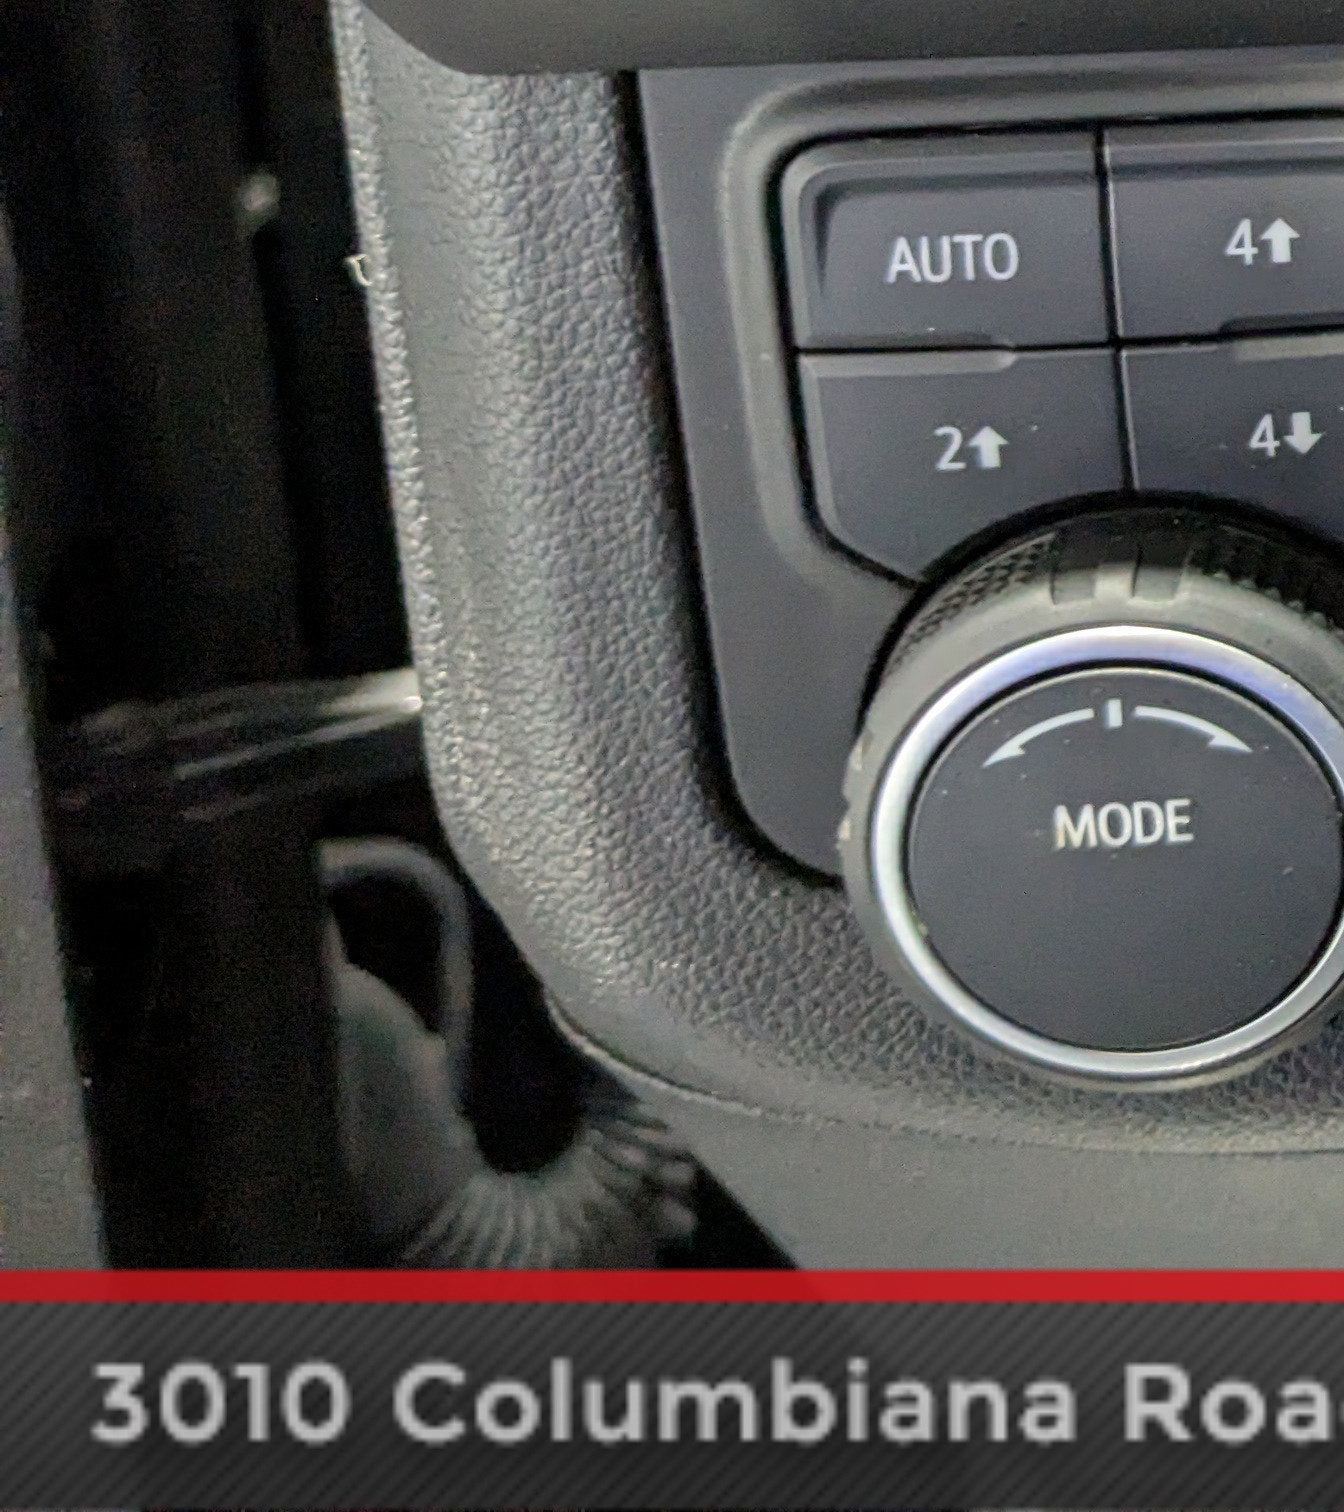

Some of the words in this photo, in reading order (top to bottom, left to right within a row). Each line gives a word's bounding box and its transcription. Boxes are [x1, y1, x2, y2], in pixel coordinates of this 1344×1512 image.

[884, 232, 1020, 284] AUTO
[1224, 218, 1259, 266] 4
[933, 425, 966, 471] 2
[1248, 414, 1281, 458] 4
[1052, 797, 1194, 850] MODE
